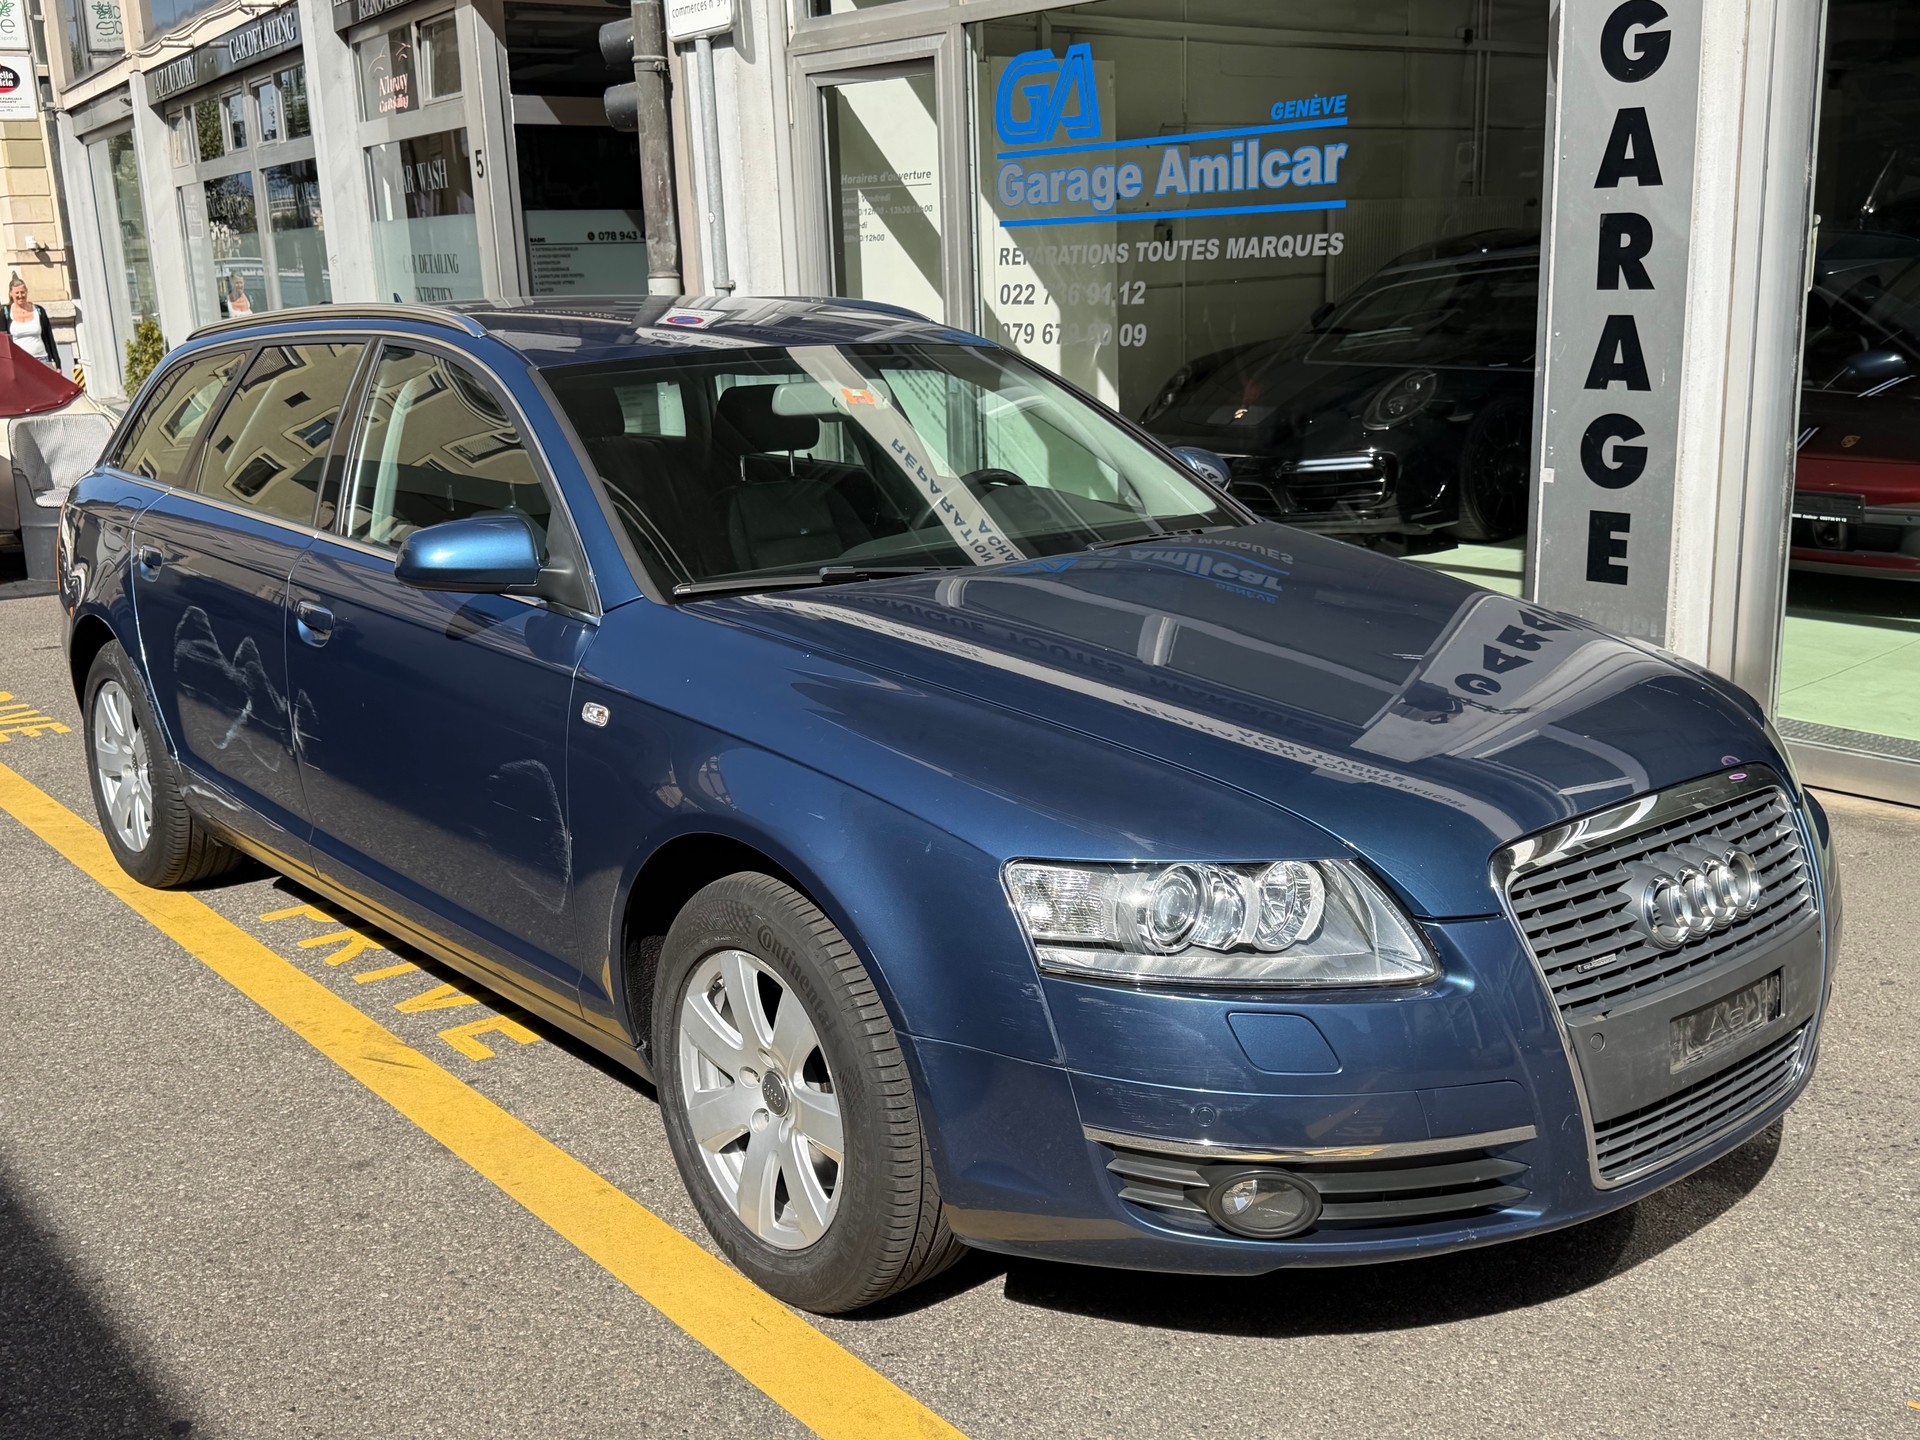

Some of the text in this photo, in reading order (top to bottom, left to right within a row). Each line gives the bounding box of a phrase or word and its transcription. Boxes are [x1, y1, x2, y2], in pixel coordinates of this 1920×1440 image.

[672, 0, 708, 18] commerces
[248, 12, 296, 56] DETAILING
[164, 55, 196, 95] LUXURY
[1270, 93, 1348, 121] GENÈVE
[394, 159, 449, 194] CAR WASH
[475, 150, 484, 179] 5
[997, 138, 1348, 213] Garage Amilcar
[841, 173, 878, 185] Horaires
[598, 231, 617, 241] 078
[619, 230, 638, 240] 943
[1136, 239, 1220, 262] TOUTES
[1226, 232, 1344, 260] MARQUES
[418, 253, 460, 275] DETAILING
[415, 286, 454, 302] NTRETIEN
[1000, 283, 1035, 305] 022
[1119, 280, 1147, 305] 12
[1580, 0, 1671, 586] GARAGE
[1000, 322, 1035, 345] 079
[1119, 323, 1147, 347] 09
[756, 924, 838, 1028] Continental
